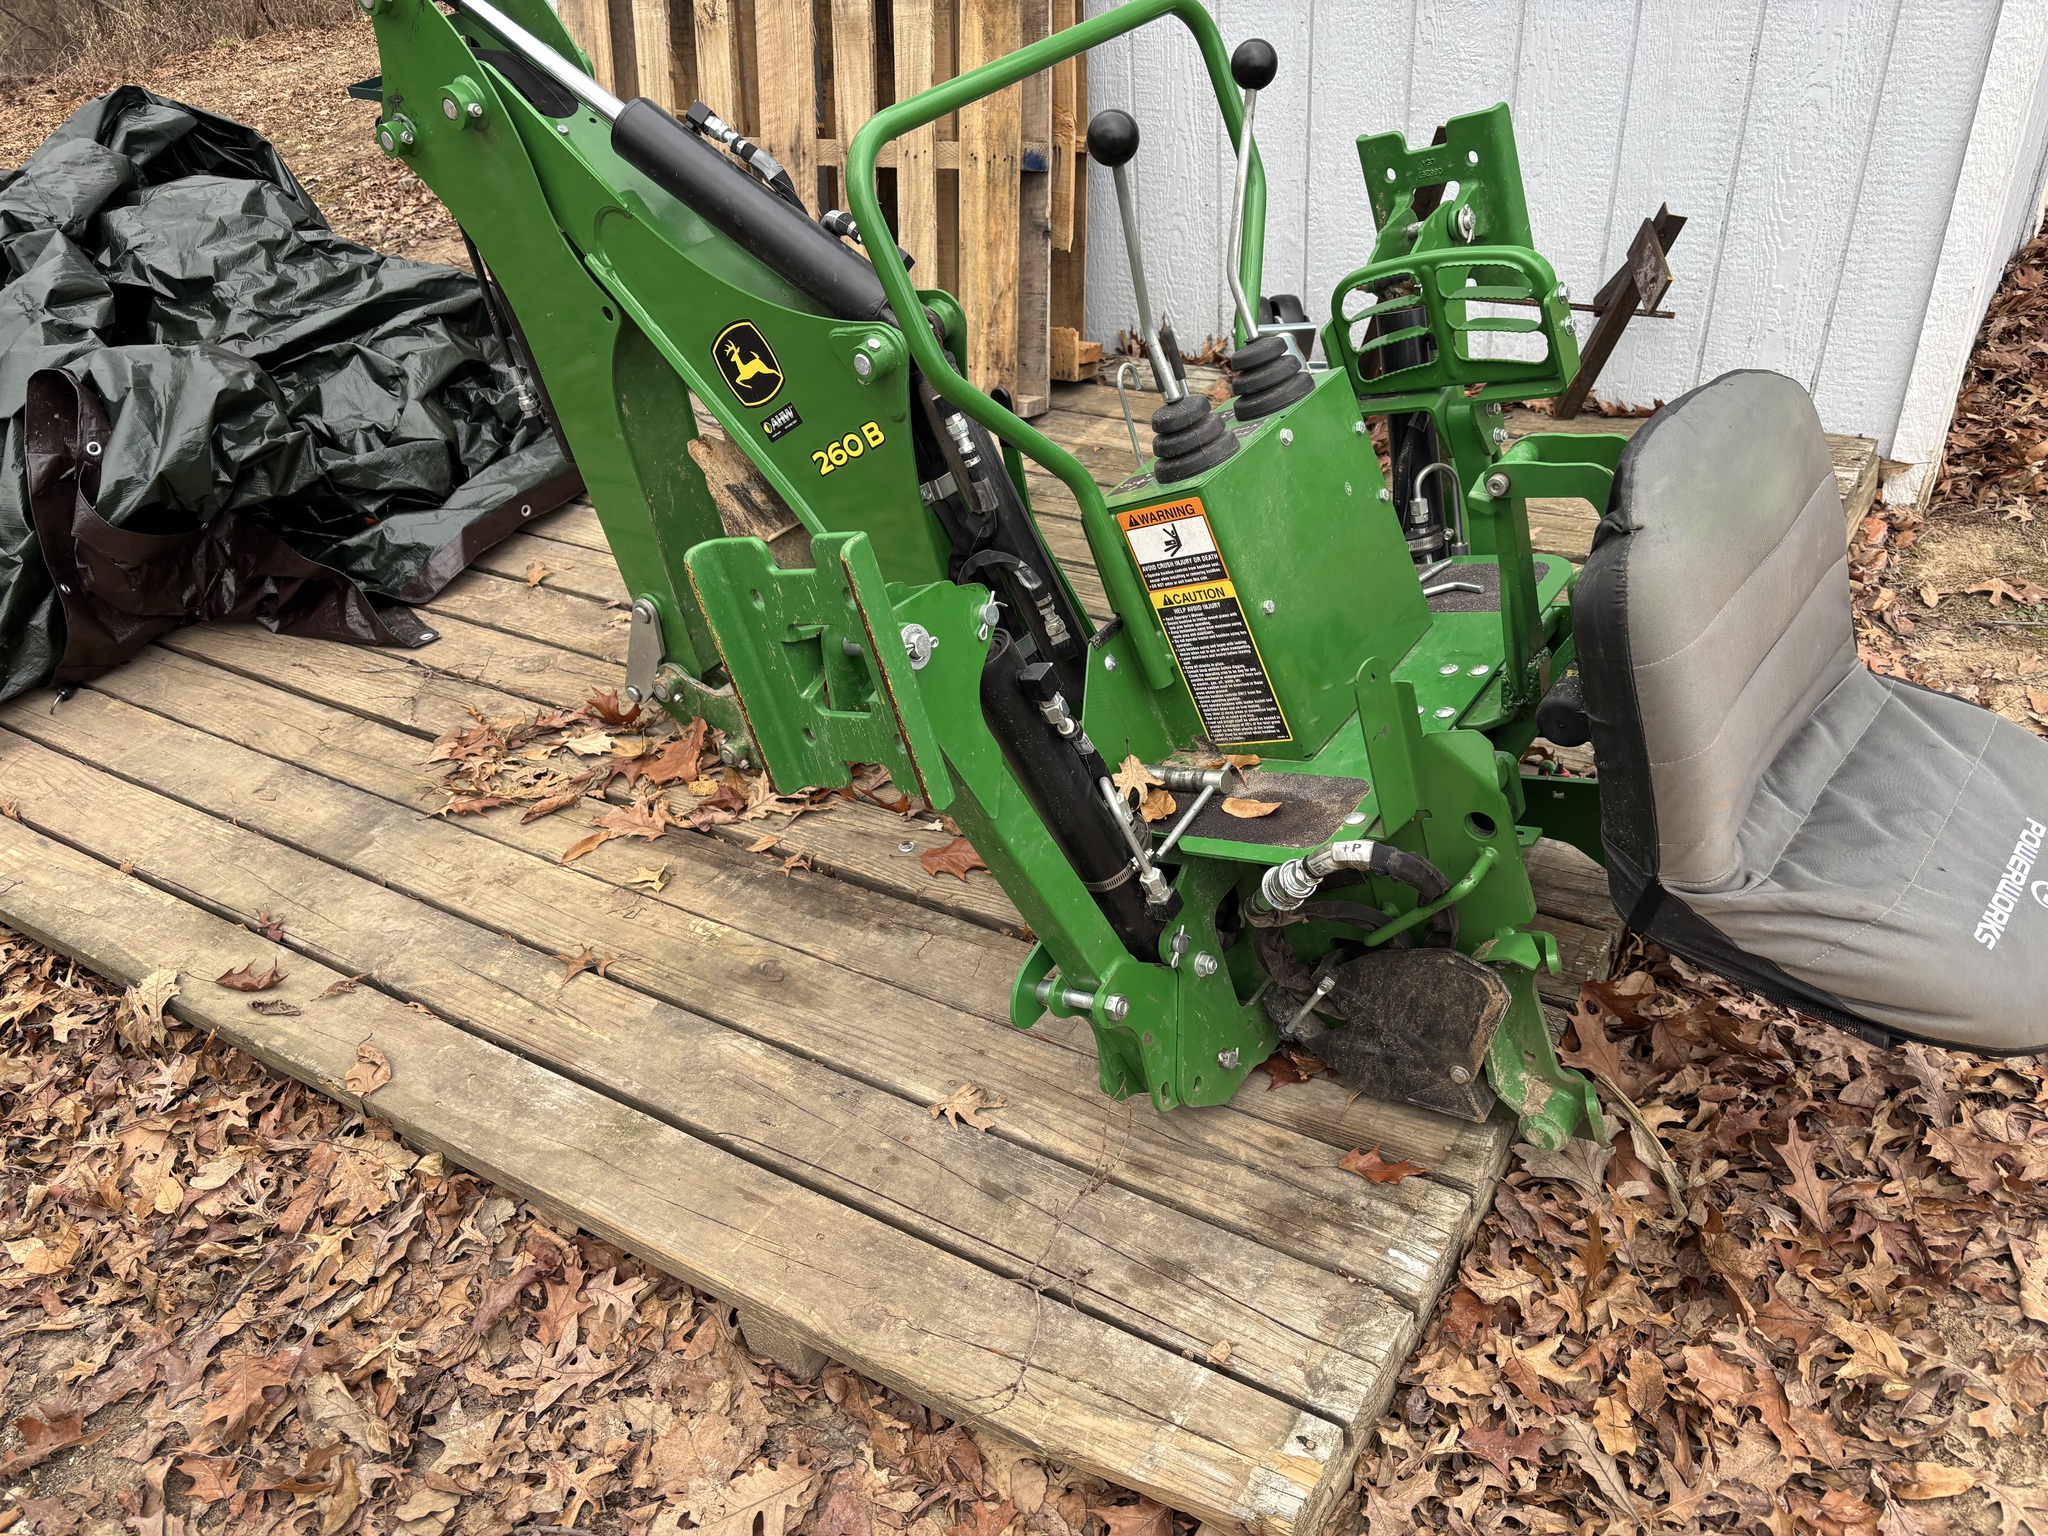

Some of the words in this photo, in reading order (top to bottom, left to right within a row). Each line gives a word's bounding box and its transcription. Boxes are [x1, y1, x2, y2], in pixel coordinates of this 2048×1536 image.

[770, 407, 795, 431] AHW
[811, 432, 865, 476] 260
[860, 420, 886, 449] B
[1137, 503, 1195, 525] WARNING
[1141, 564, 1157, 572] AVOID
[1156, 561, 1174, 569] CRUSH
[1173, 557, 1192, 566] INJURY
[1201, 552, 1218, 561] DEATH
[1171, 586, 1225, 604] CAUTION
[1186, 604, 1202, 612] AVOID
[1973, 816, 2047, 951] POWERWORKS
